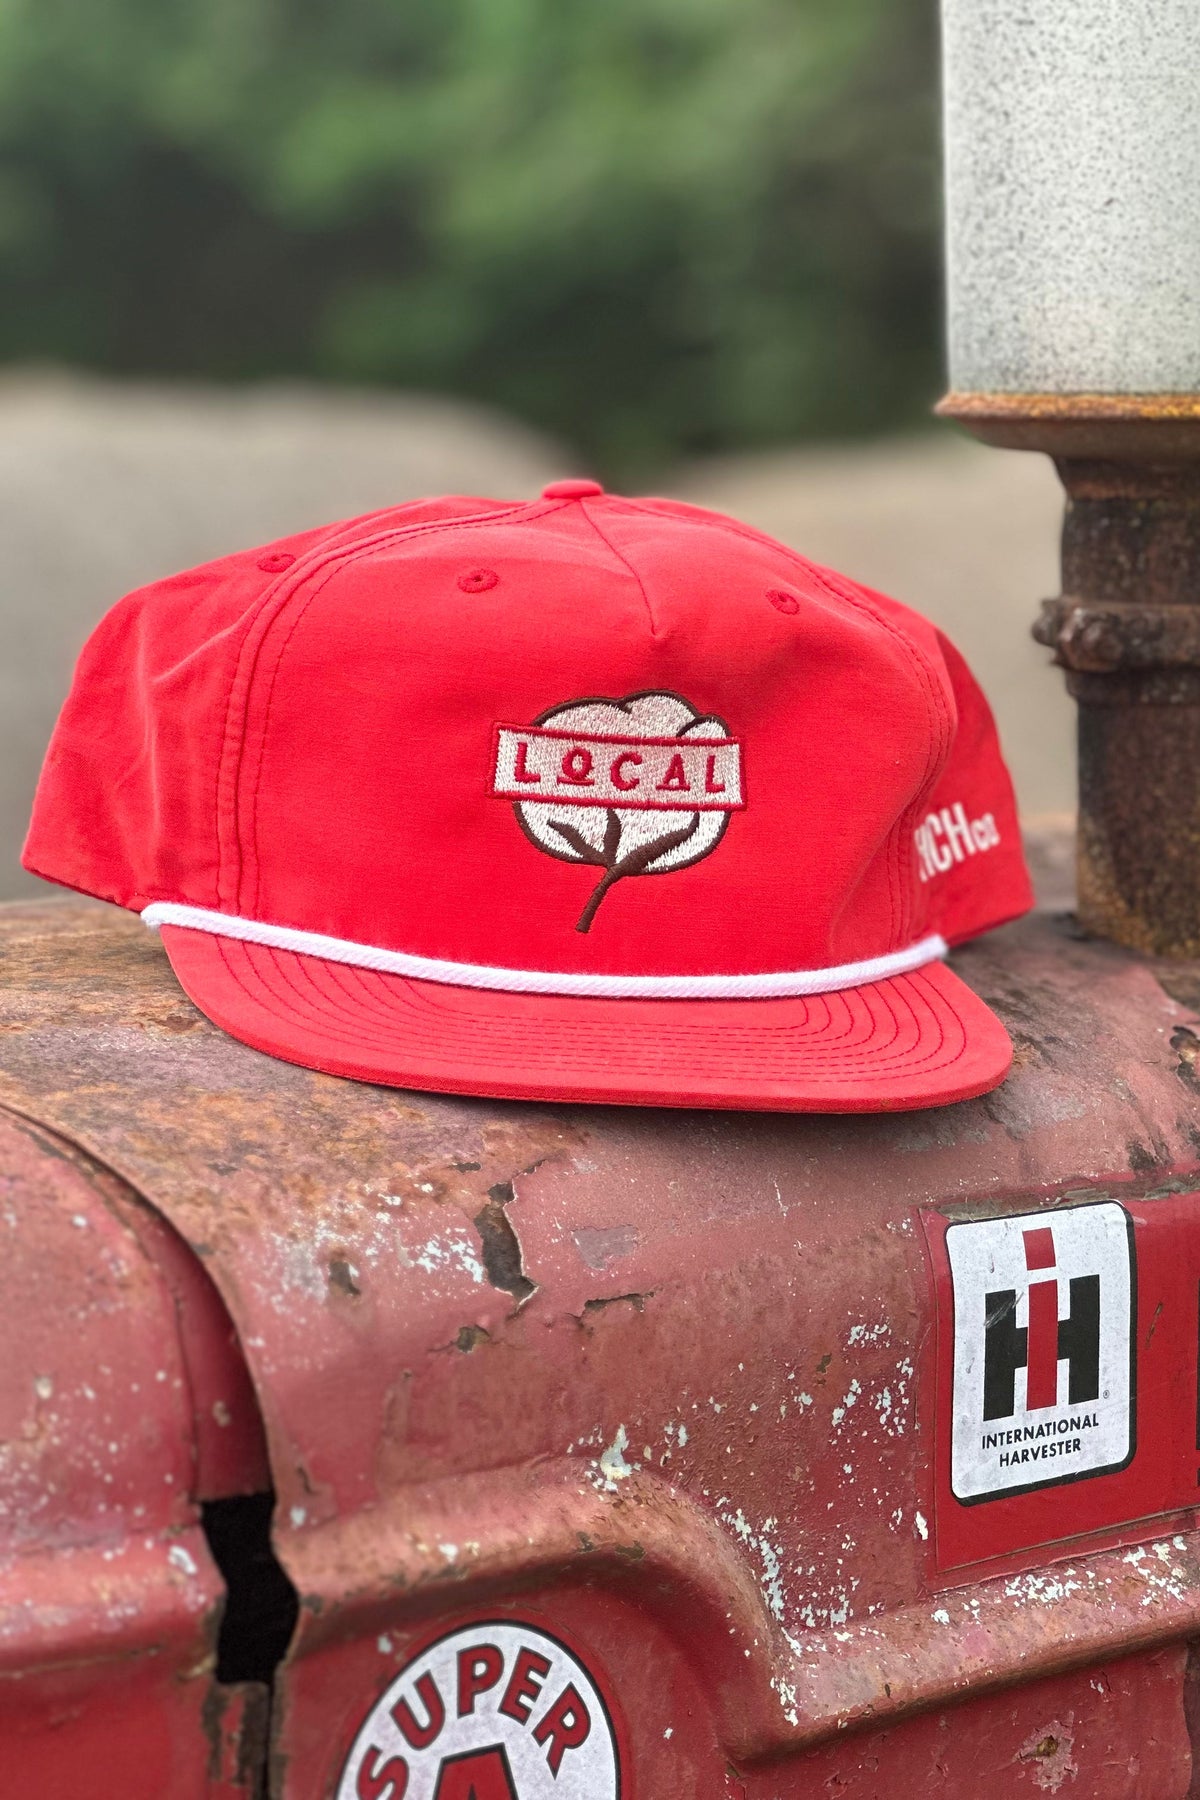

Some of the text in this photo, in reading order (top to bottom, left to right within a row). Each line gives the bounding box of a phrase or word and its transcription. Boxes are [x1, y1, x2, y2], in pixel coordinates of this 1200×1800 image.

[513, 741, 726, 794] LOCAL
[981, 1413, 1099, 1449] INTERNATIONAL
[999, 1437, 1082, 1467] HARVESTER
[357, 1643, 591, 1800] SUPER
